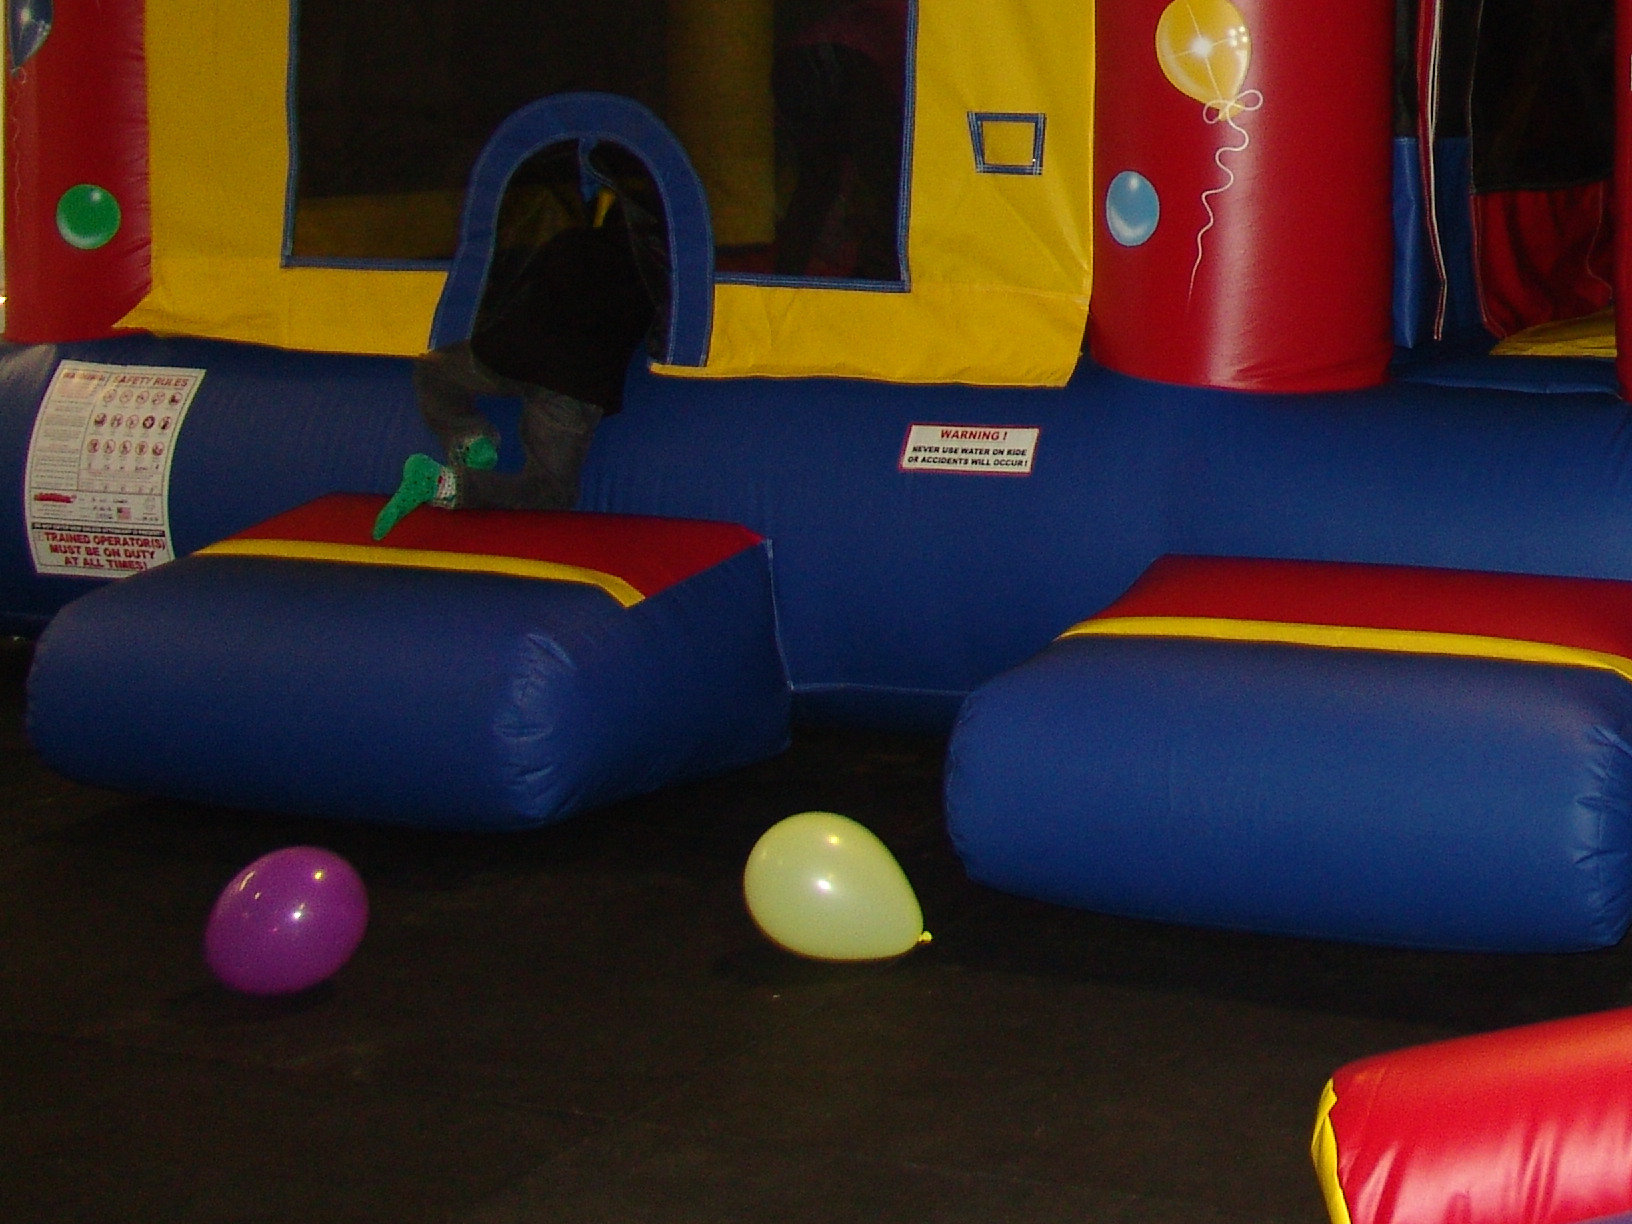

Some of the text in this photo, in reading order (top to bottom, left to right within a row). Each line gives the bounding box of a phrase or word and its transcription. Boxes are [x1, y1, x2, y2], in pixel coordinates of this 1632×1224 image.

[153, 377, 189, 388] RULES
[940, 429, 1000, 441] WARNING
[912, 445, 1027, 457] NEVER USE WATER ON RIDE
[921, 456, 968, 465] ACCIDENTS
[971, 458, 991, 466] WILL
[44, 531, 166, 550] TRAINED OPERATOR(S)
[50, 544, 155, 559] MUST BE ON DUTY
[64, 556, 79, 566] AT
[82, 557, 104, 568] ALL
